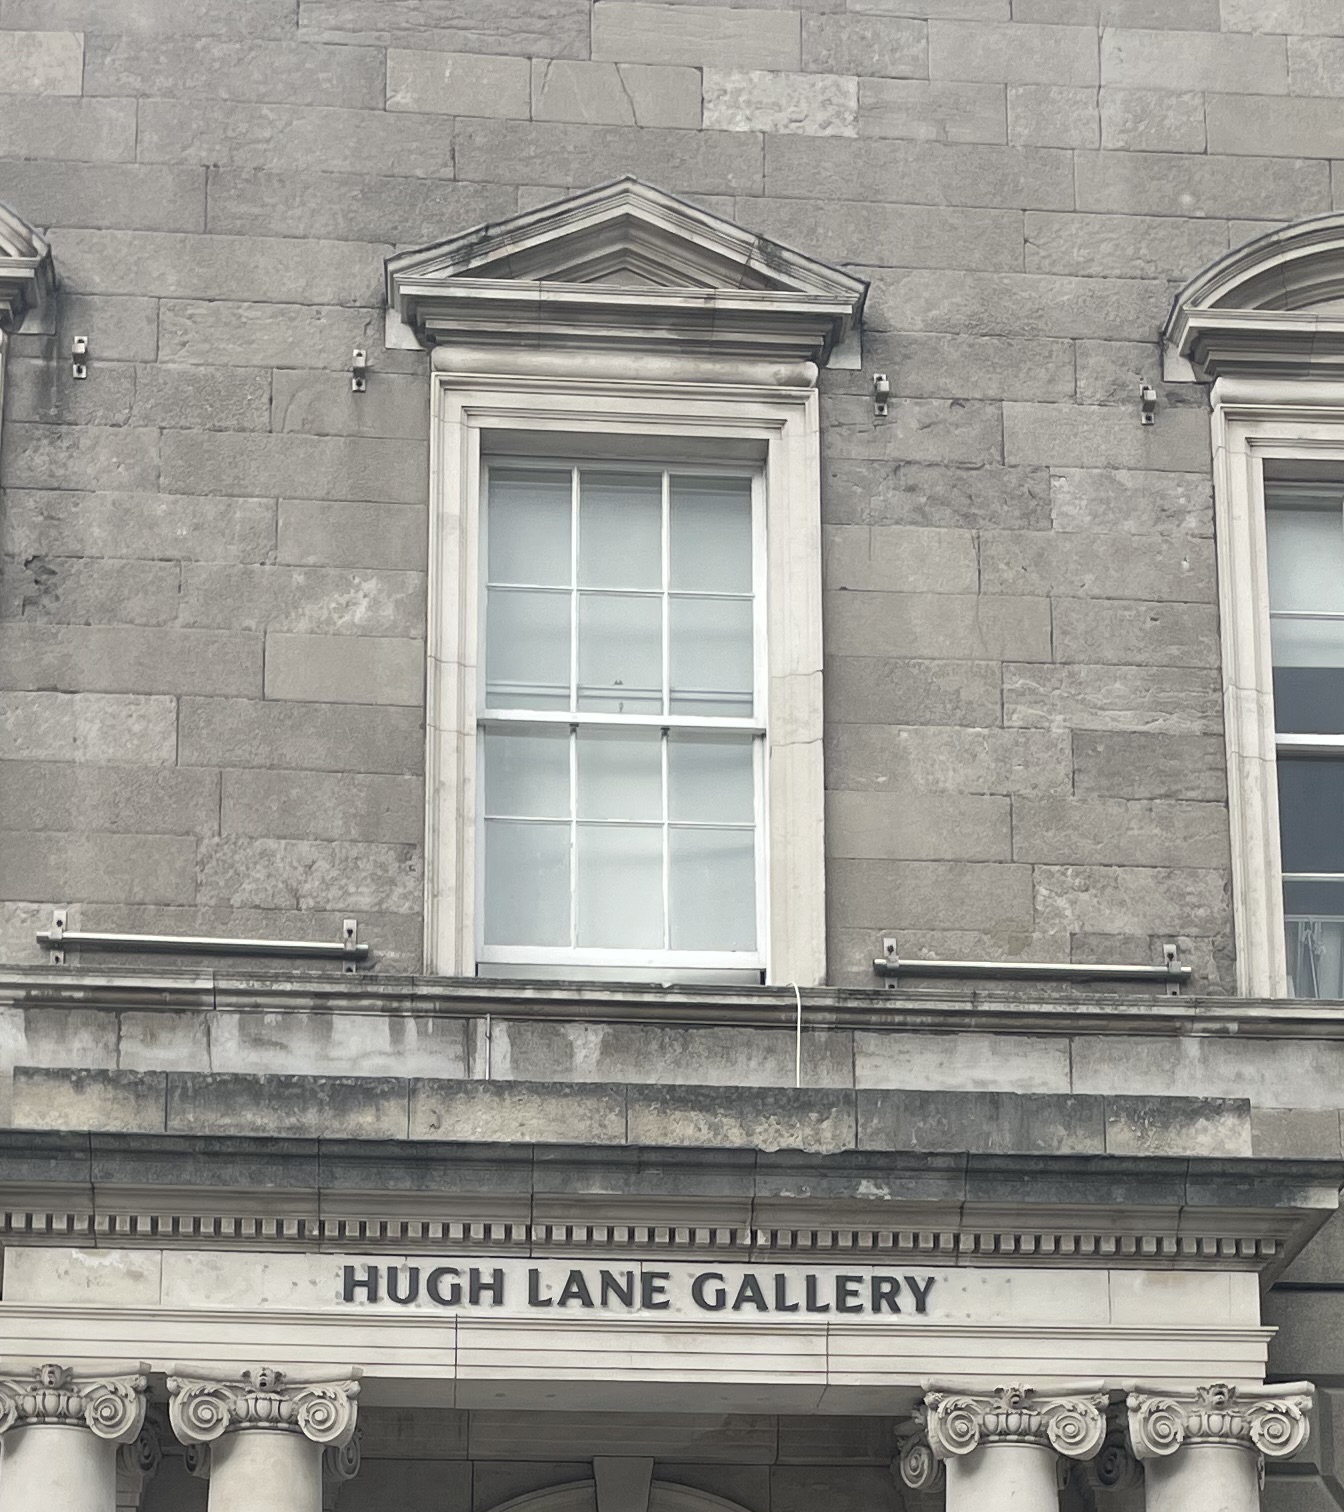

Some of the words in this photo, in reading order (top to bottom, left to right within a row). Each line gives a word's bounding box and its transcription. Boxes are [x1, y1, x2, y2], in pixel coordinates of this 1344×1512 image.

[342, 1265, 505, 1306] HUGH
[528, 1267, 671, 1311] LANE
[691, 1271, 936, 1314] GALLERY
